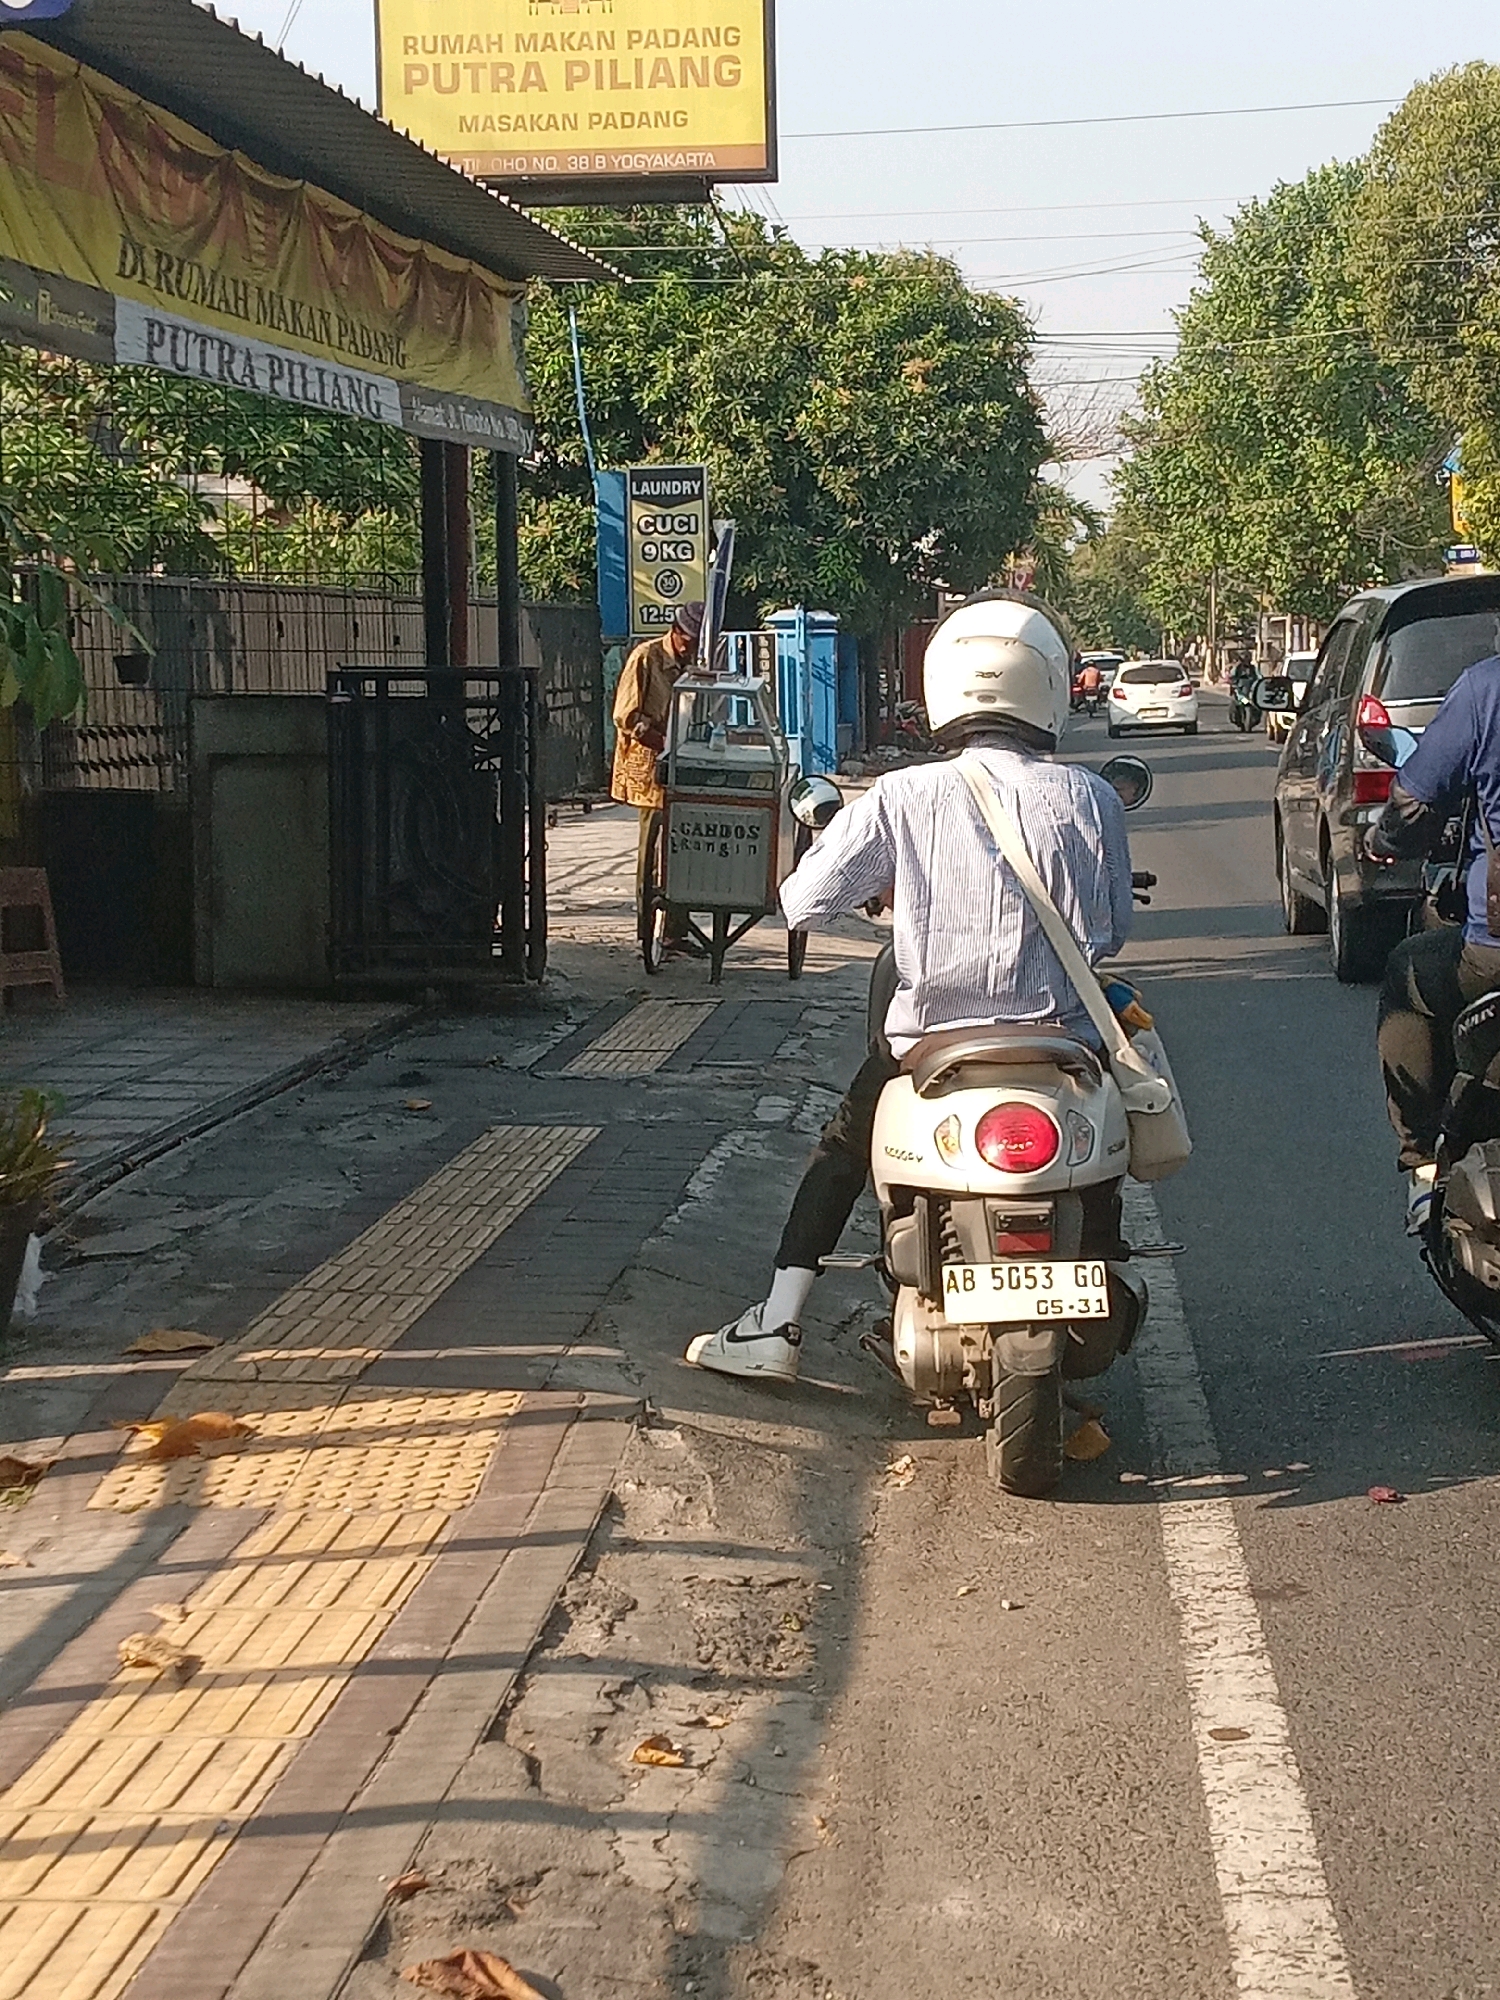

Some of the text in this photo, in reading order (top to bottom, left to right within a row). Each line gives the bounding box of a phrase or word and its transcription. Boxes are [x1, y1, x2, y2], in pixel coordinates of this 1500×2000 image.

[403, 26, 741, 56] RUMAH MAKAN PADANG
[403, 55, 741, 95] PUTRA PILIANG
[459, 110, 688, 133] MASAKAN PADANG
[533, 157, 560, 171] NO.
[567, 157, 589, 170] 38
[610, 152, 716, 168] YOGYAKARTA
[116, 234, 150, 287] DI
[154, 248, 250, 321] RUMAH
[255, 286, 334, 347] MAKAN
[336, 313, 407, 370] PADANG
[144, 317, 383, 419] PUTRA PILIANG
[632, 480, 701, 495] LAUNDRY
[638, 514, 698, 535] CUCI
[946, 1268, 975, 1294] AB
[991, 1266, 1053, 1290] 5053
